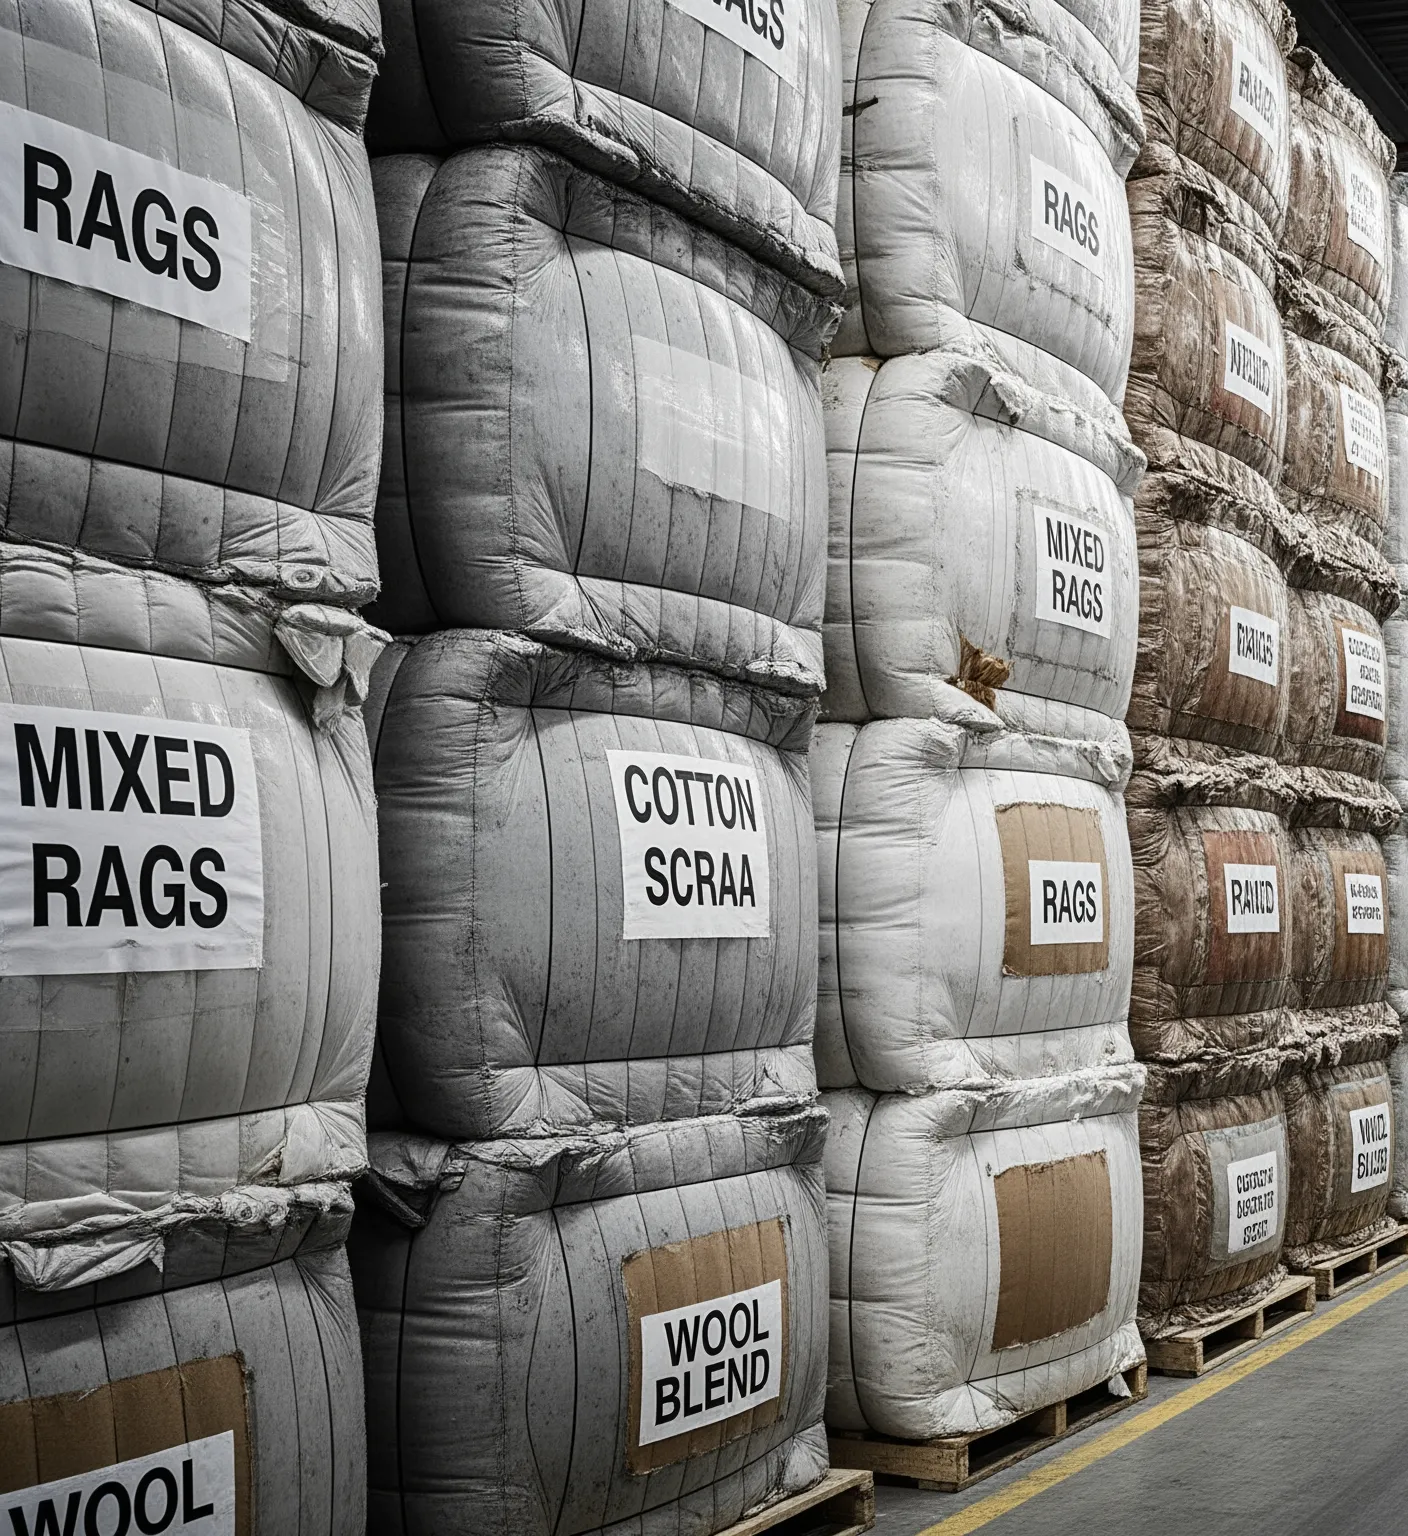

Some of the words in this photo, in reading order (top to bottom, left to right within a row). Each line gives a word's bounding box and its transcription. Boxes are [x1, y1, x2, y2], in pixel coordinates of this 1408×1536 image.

[713, 0, 784, 50] GS
[24, 143, 221, 291] RAGS
[1045, 181, 1098, 257] RAGS
[1046, 516, 1103, 573] MIXED
[1052, 569, 1102, 623] RAGS
[14, 723, 234, 818] MIXED
[625, 765, 756, 831] COTTON
[33, 843, 228, 929] RAGS
[645, 847, 756, 908] SCRAA
[1043, 880, 1096, 923] RAGS
[664, 1299, 770, 1367] WOOL
[654, 1350, 770, 1426] BLEND
[8, 1458, 214, 1536] WOOL
